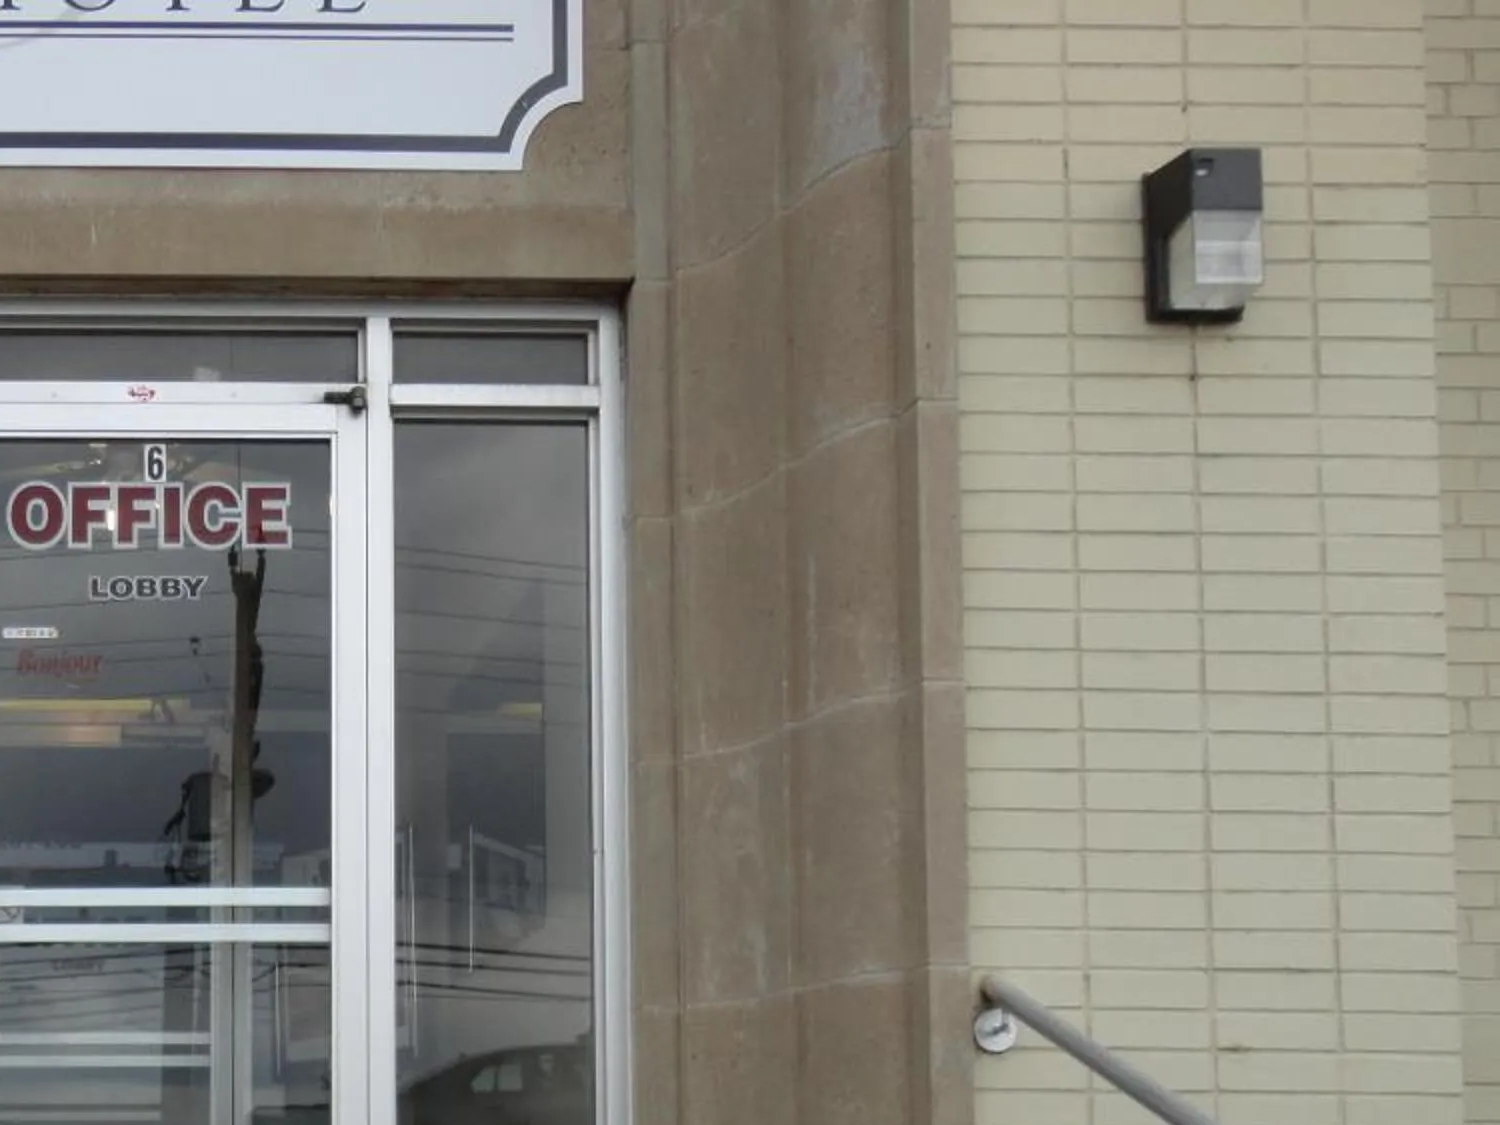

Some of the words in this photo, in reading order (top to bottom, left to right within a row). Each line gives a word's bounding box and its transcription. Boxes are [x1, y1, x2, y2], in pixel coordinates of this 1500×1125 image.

[147, 447, 164, 481] 6
[8, 481, 291, 549] OFFICE
[90, 576, 206, 599] LOBBY
